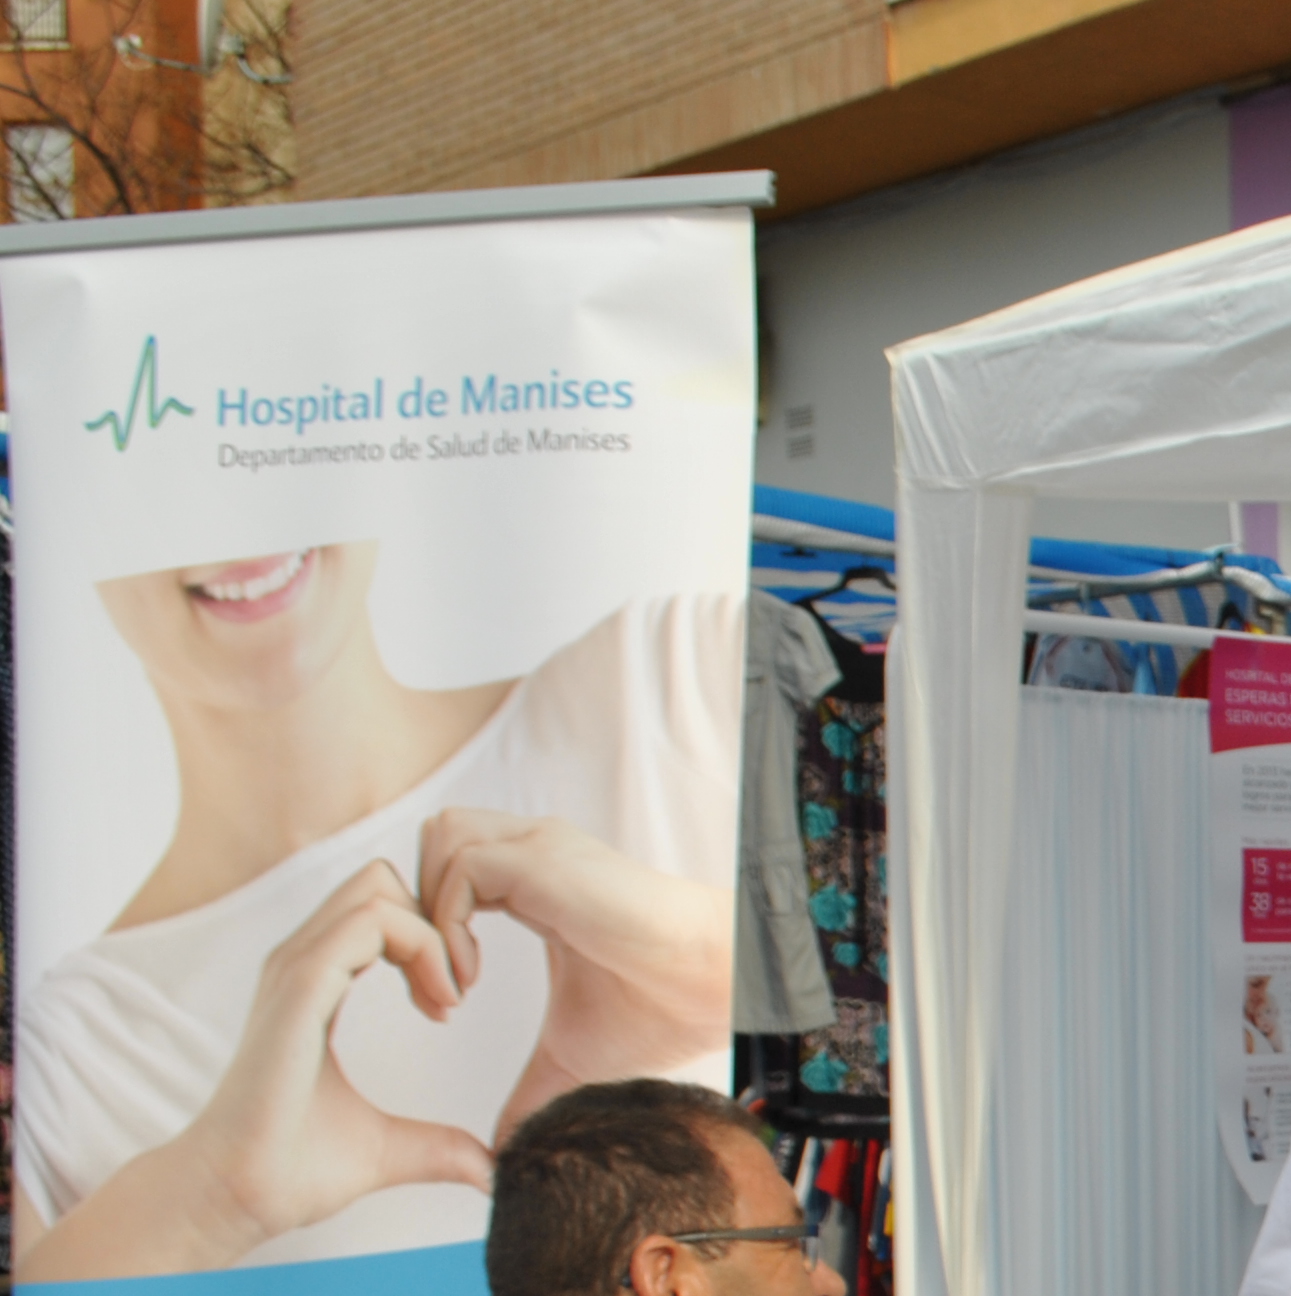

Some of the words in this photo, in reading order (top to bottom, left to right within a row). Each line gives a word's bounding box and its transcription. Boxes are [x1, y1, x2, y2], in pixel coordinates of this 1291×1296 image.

[217, 378, 385, 433] Hospital
[397, 376, 449, 420] de
[460, 369, 634, 415] Manises
[218, 436, 385, 473] Departamento
[390, 435, 421, 462] de
[427, 431, 488, 460] Salud
[493, 430, 521, 456] de
[526, 426, 630, 454] Manises
[1225, 687, 1287, 706] ESPERAS
